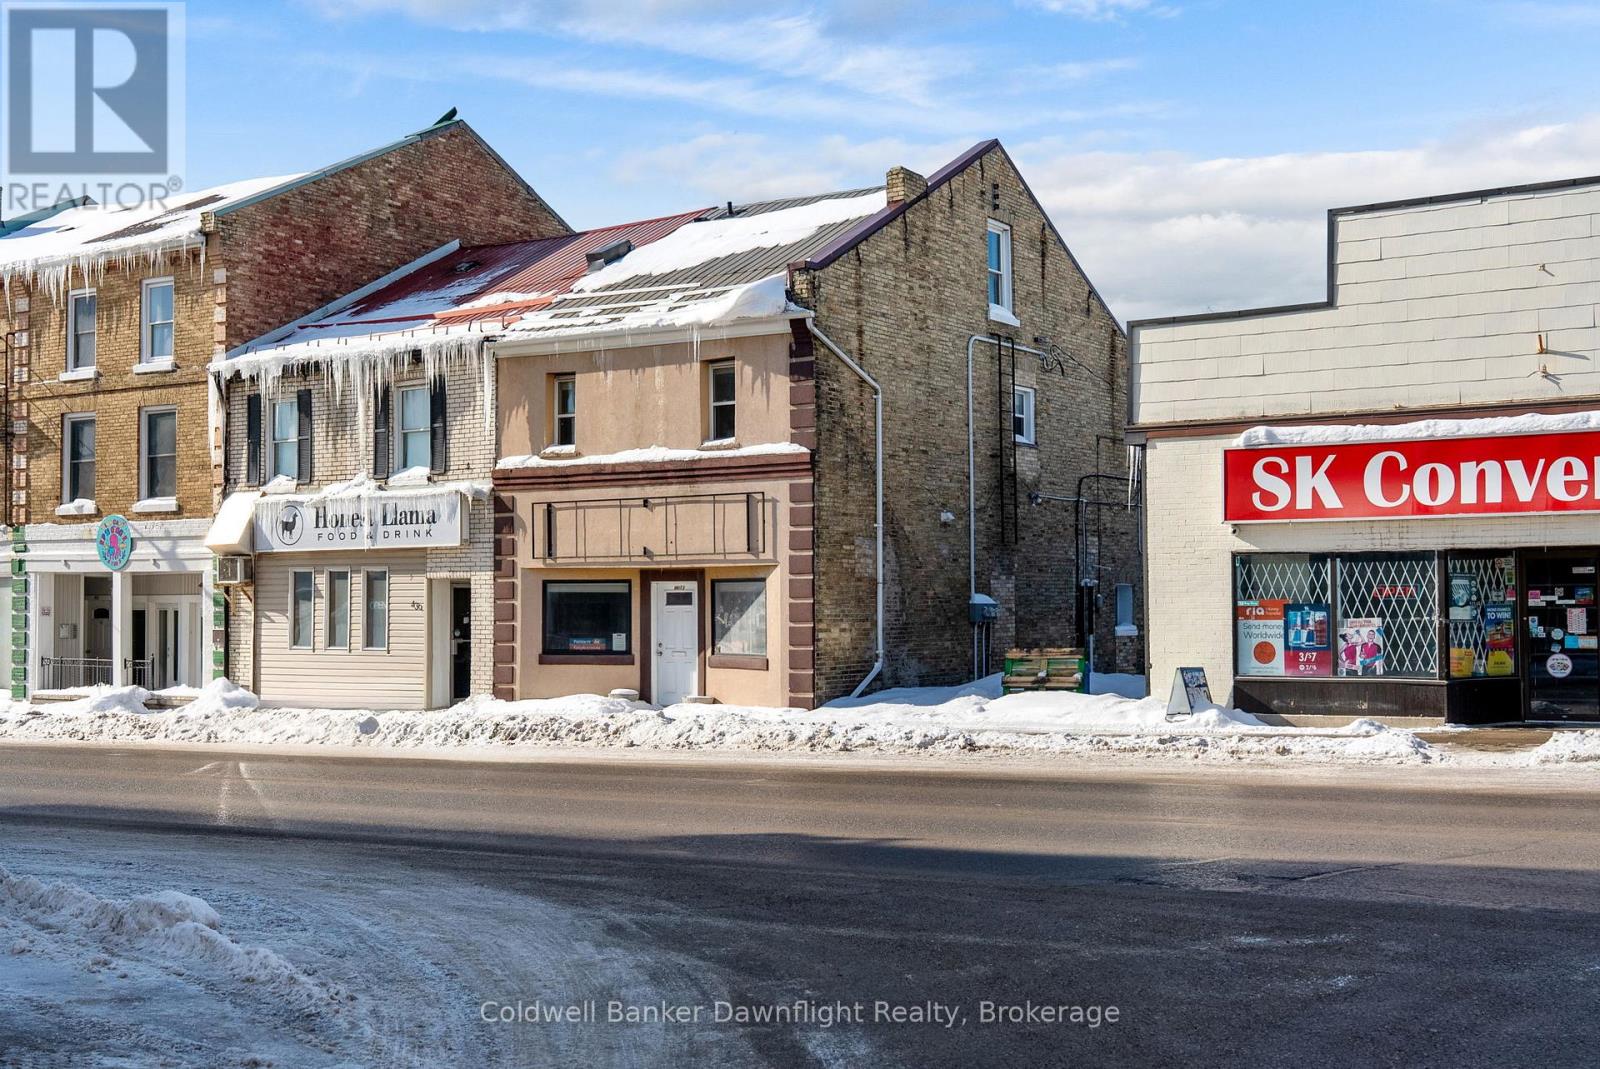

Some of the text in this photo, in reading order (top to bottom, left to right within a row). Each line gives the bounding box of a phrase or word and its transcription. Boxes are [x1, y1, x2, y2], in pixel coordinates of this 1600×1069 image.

[1251, 450, 1600, 512] SK Conve
[382, 502, 437, 527] Llama
[317, 532, 357, 541] FOOD
[383, 529, 433, 539] DRINK
[1246, 607, 1265, 616] ria
[1243, 622, 1261, 630] Send
